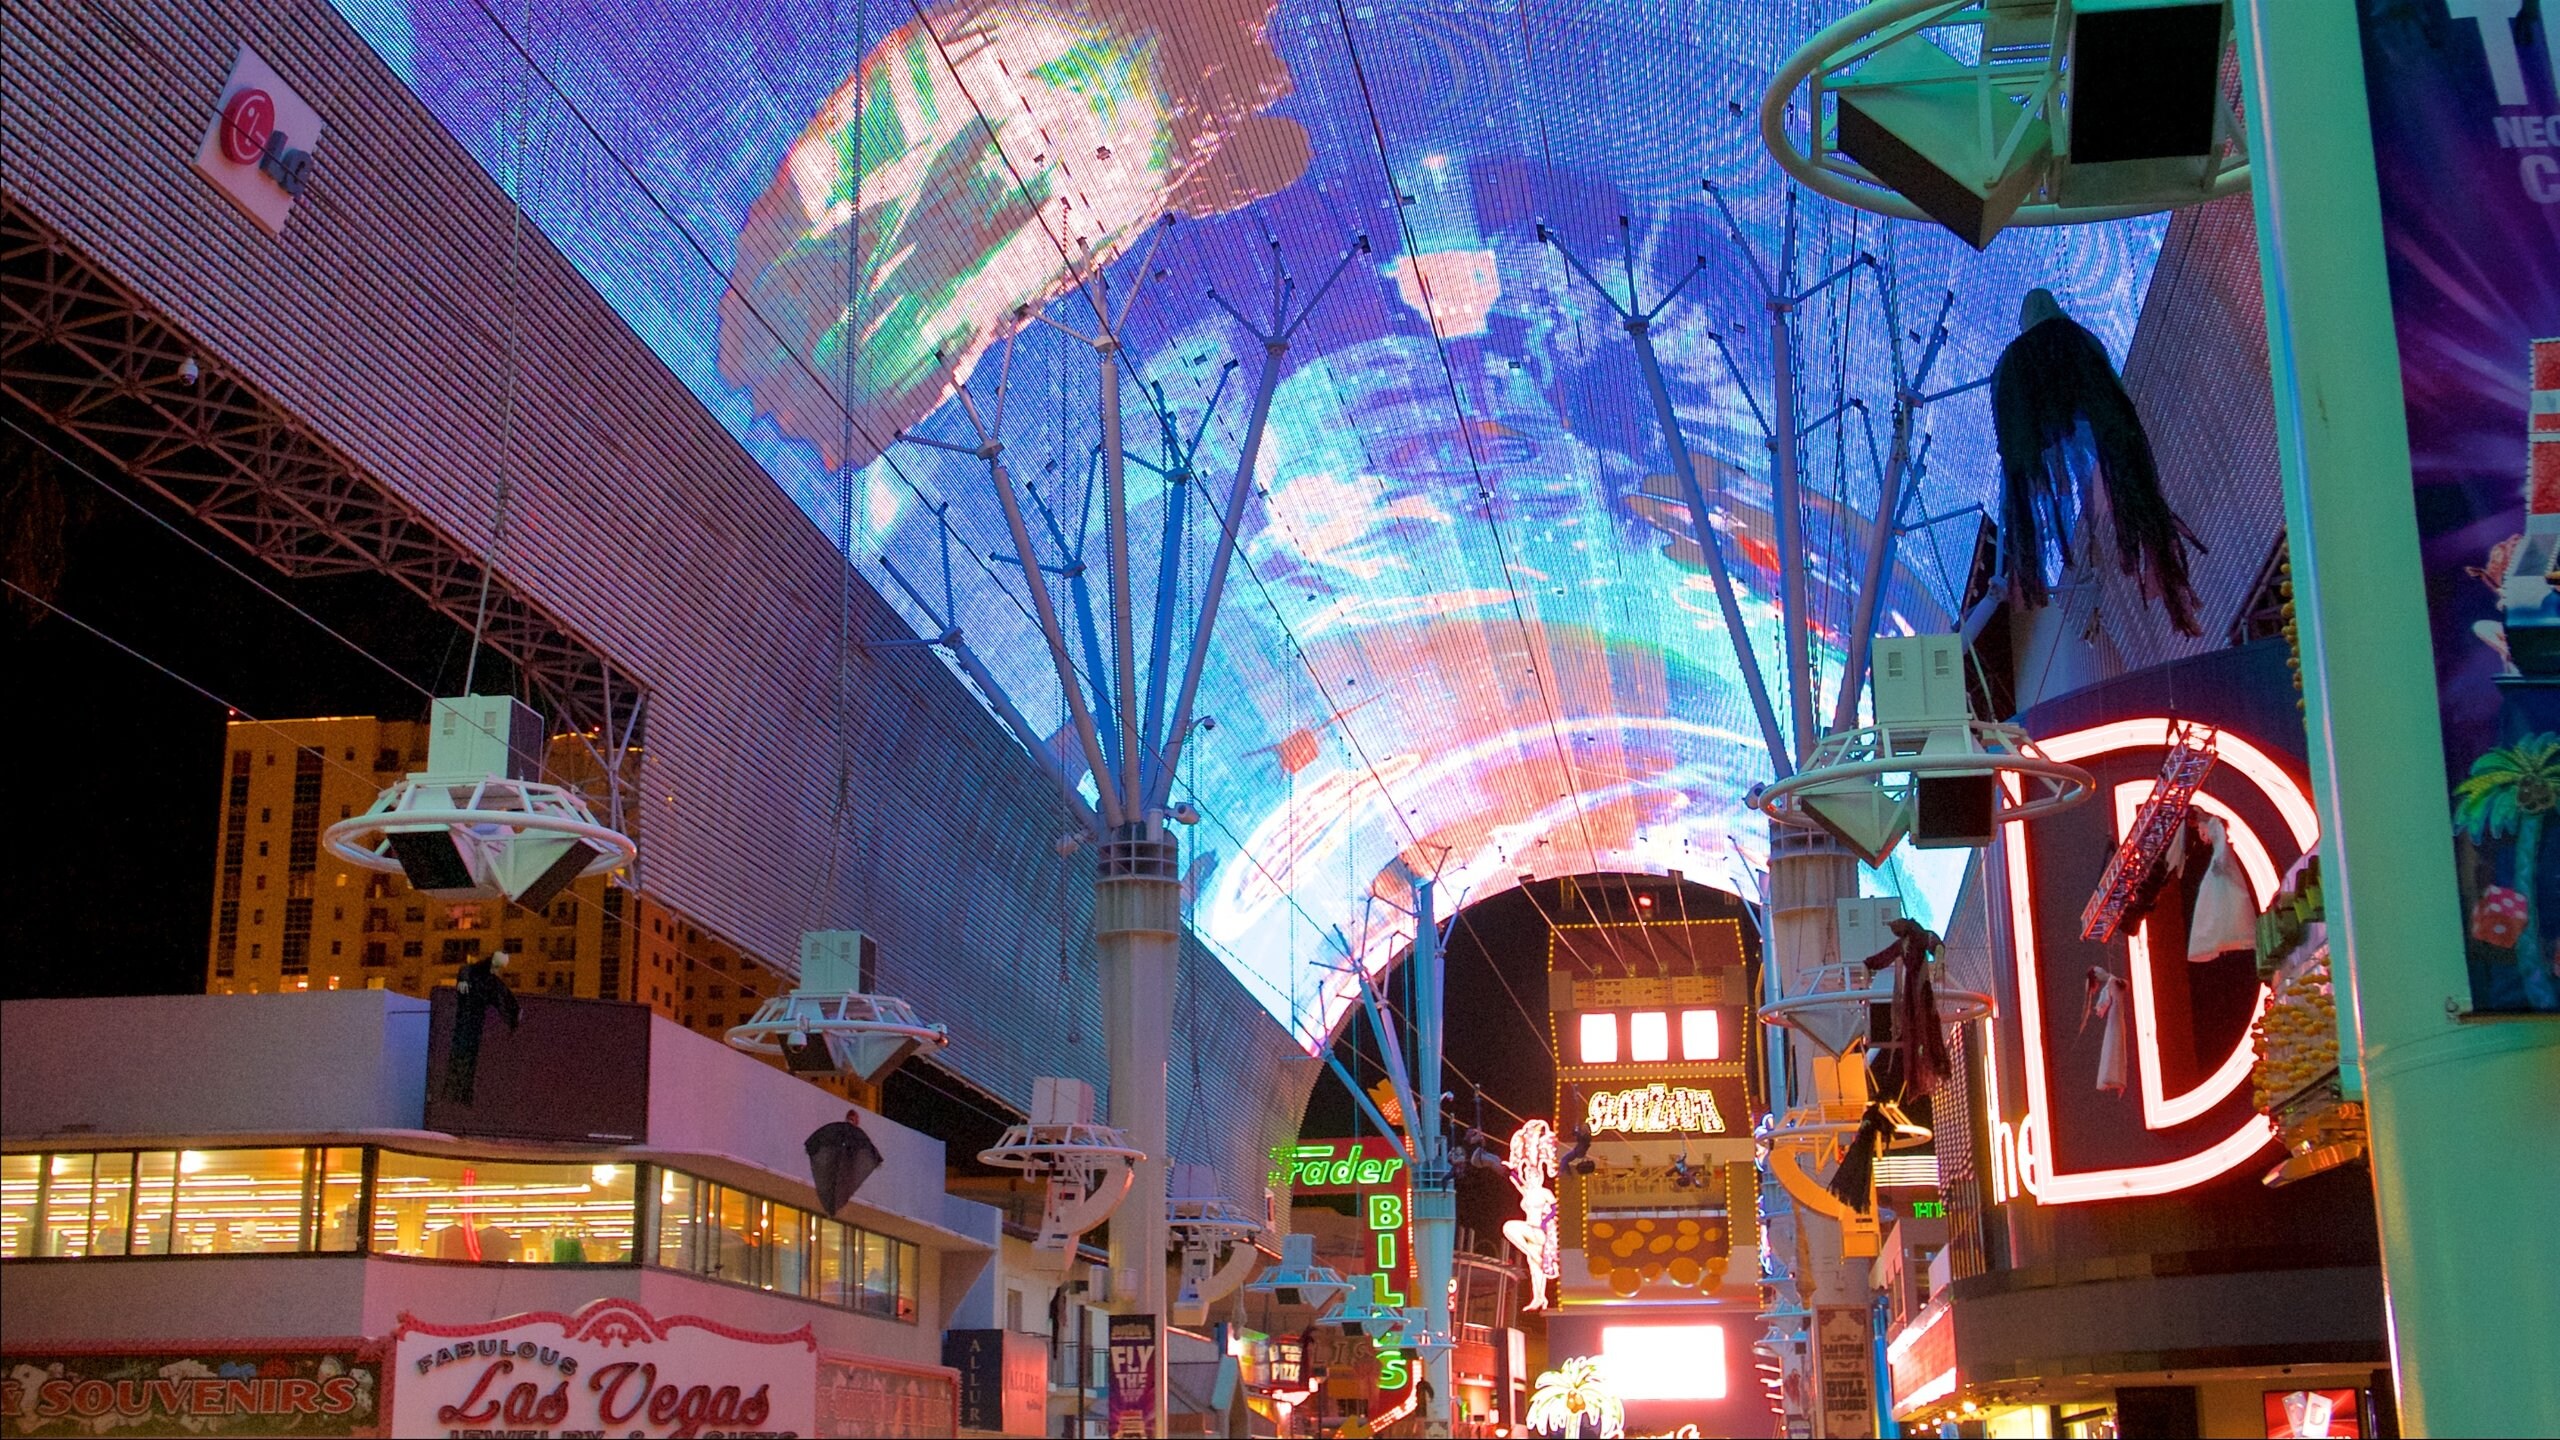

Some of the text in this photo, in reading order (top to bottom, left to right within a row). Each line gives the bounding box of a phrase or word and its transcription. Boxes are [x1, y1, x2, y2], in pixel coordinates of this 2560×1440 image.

[417, 1339, 578, 1376] FABULOUS
[1110, 1345, 1155, 1373] FLY
[36, 1377, 360, 1417] SOUVENIRS
[438, 1360, 771, 1438] Las Vegas
[1115, 1373, 1148, 1390] THE
